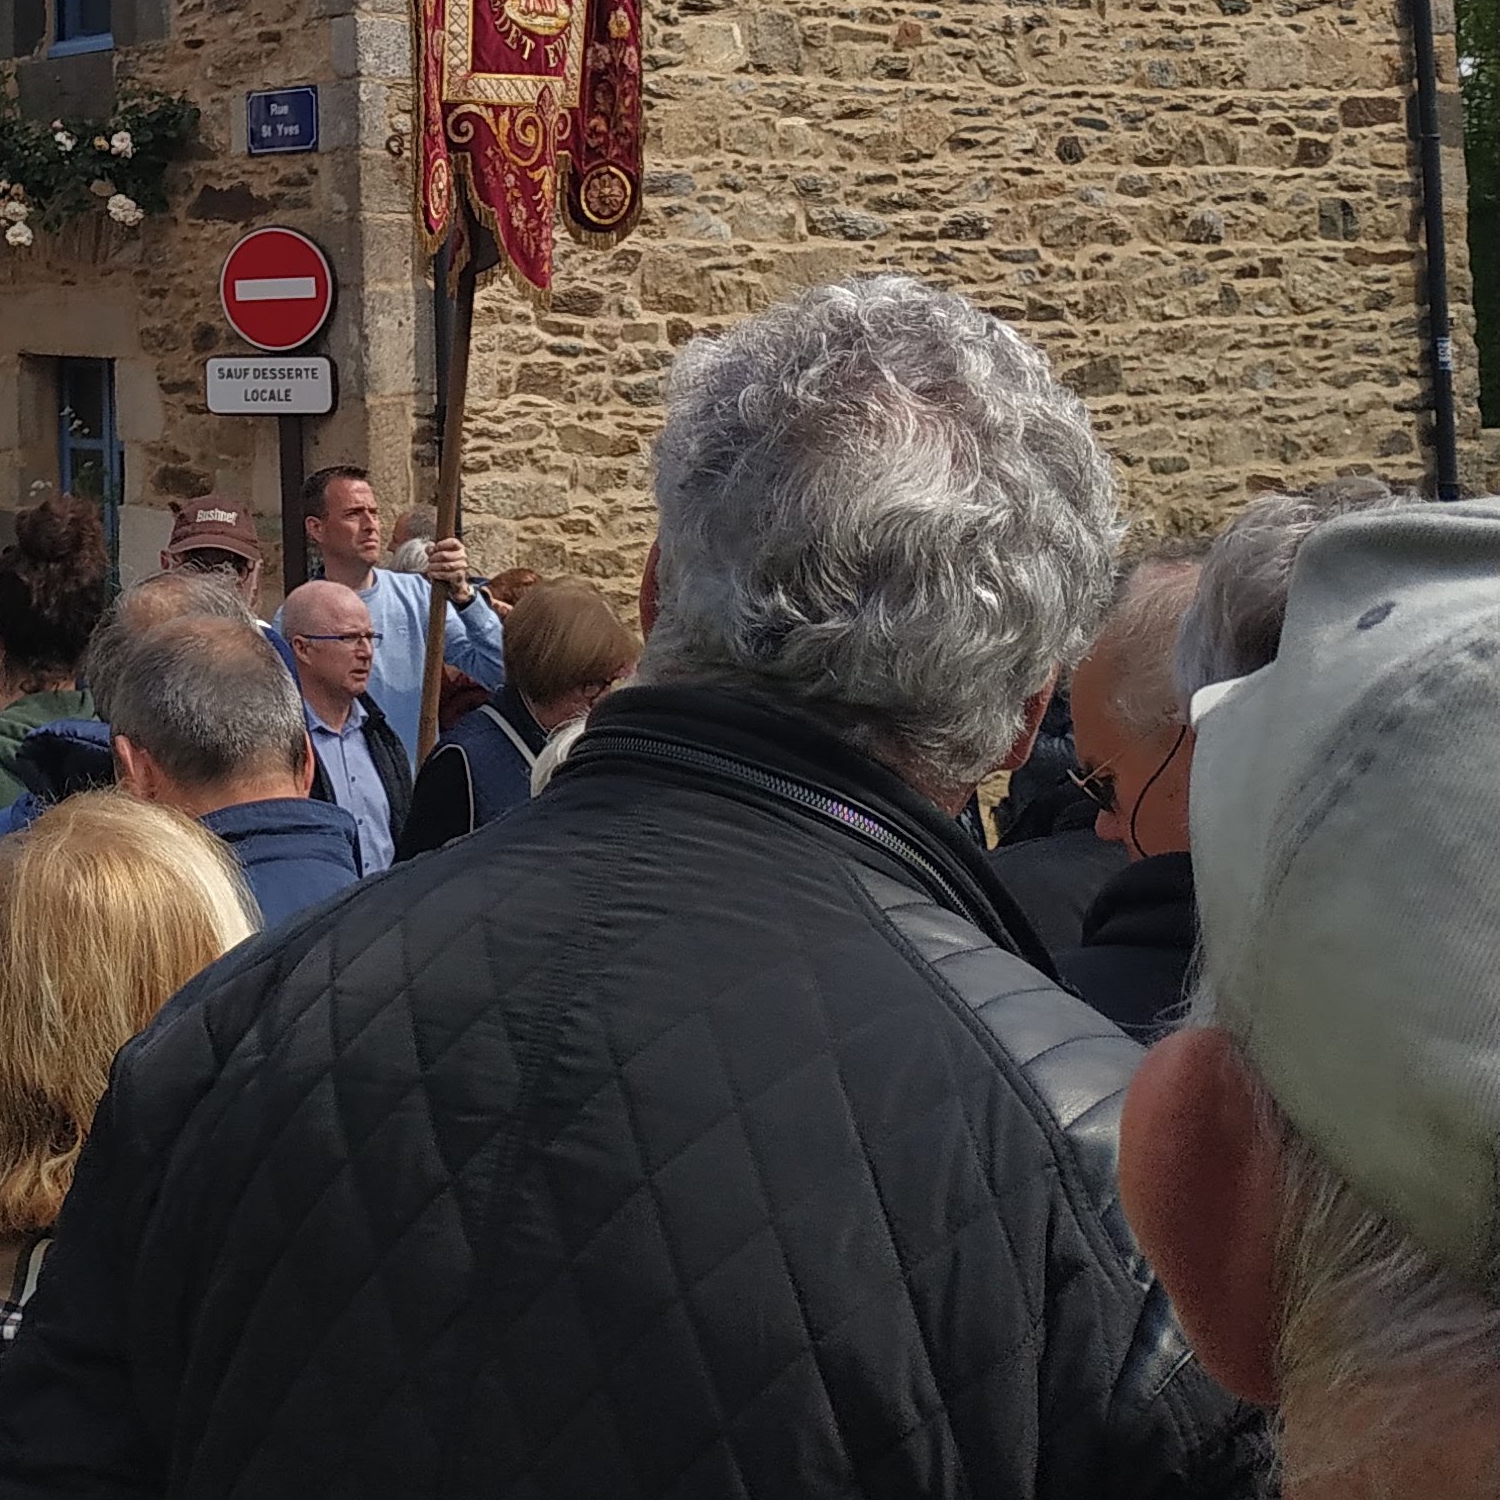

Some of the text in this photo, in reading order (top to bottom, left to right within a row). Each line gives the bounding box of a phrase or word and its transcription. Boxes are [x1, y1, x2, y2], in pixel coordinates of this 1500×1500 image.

[270, 103, 289, 116] Rue
[276, 123, 300, 136] Yves
[217, 367, 319, 380] SAUF DESSERTE
[244, 388, 293, 402] LOCALE
